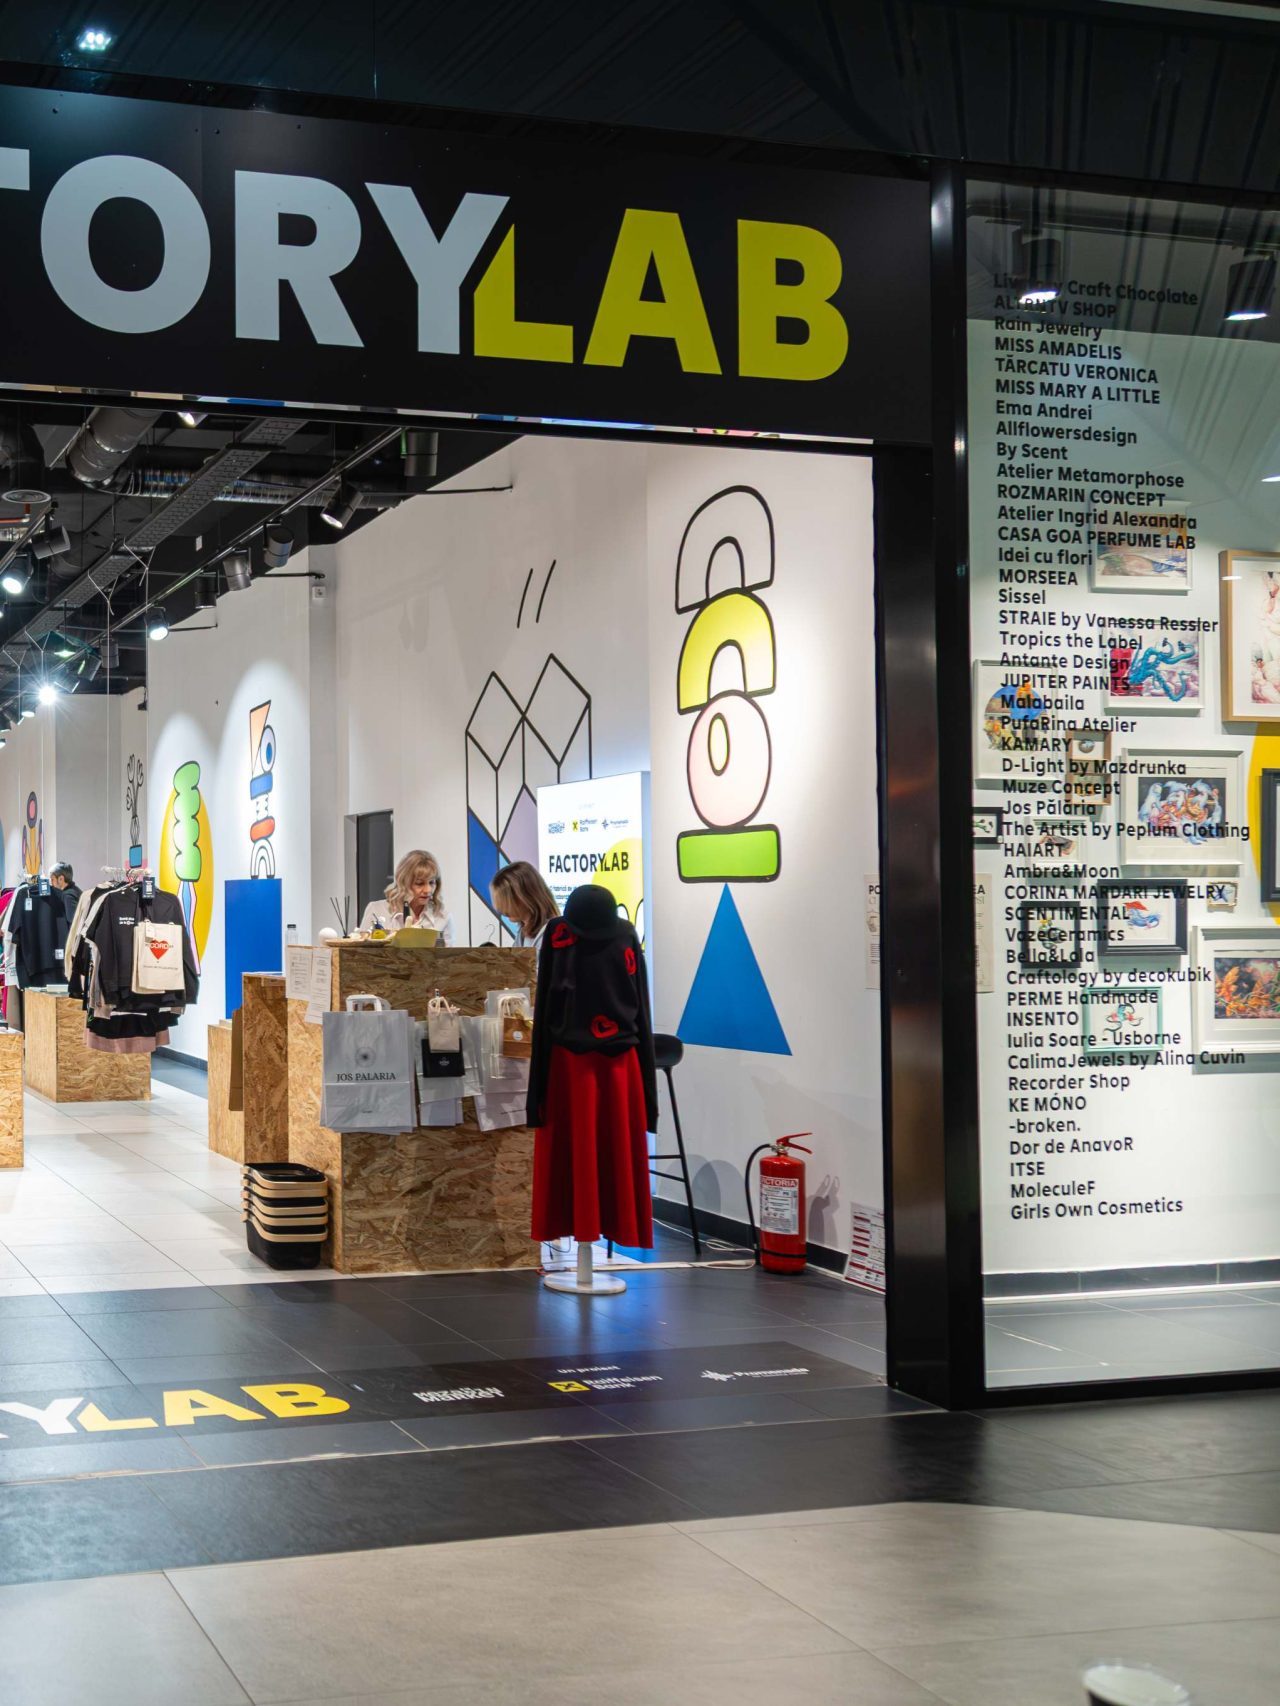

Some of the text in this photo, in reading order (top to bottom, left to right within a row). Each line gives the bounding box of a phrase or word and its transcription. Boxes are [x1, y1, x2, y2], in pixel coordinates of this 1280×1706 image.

[1068, 280, 1111, 298] Craft
[1116, 284, 1198, 306] Chocolate
[1073, 303, 1117, 318] SHOP
[995, 316, 1102, 340] Rain Jewelry
[995, 338, 1122, 360] MISS AMADELIS
[996, 355, 1158, 383] TĂRCATU VERONICA
[996, 379, 1160, 404] MISS MARY A LITTLE
[996, 400, 1092, 420] Ema Andrei
[996, 421, 1137, 446] Allflowersdesign
[997, 442, 1068, 460] By Scent
[997, 463, 1184, 489] Atelier Metamorphose
[998, 484, 1165, 506] ROZMARIN CONCEPT
[998, 505, 1196, 529] Atelier Ingrid Alexandra
[998, 526, 1196, 550] CASA GOA PERFUME LAB
[999, 548, 1092, 565] Idei cu flori
[999, 569, 1078, 586] MORSEEA
[999, 588, 1046, 604] Sissel
[999, 610, 1218, 632] STRAIE by Vanessa Ressler
[1000, 631, 1143, 650] Tropics the Label
[1000, 652, 1130, 672] Antante Design
[1000, 674, 1130, 690] JUPITER PAINTS
[1001, 694, 1084, 710] Malabaila
[1082, 718, 1136, 732] Atelier
[1002, 738, 1072, 752] KAMARY
[1002, 758, 1186, 776] D-Light by Mazdrunka
[1003, 779, 1120, 798] Muze Concept
[1003, 800, 1031, 816] Jos
[1003, 822, 1250, 840] The Artist by Peplum Clothing
[1004, 843, 1064, 857] HAIART
[549, 852, 629, 873] FACTORYLAB
[1004, 864, 1119, 879] Ambra&Moon
[1004, 885, 1225, 900] CORINA MARDARI JEWELRY
[1005, 906, 1131, 922] SCENTIMENTAL
[1007, 967, 1212, 987] Craftology by decokubik
[1008, 990, 1158, 1006] PERME Handmade
[1008, 1012, 1078, 1027] INSENTO
[1049, 1032, 1097, 1047] Soare
[1113, 1031, 1181, 1046] Usborne
[1130, 1052, 1150, 1068] by
[1154, 1051, 1195, 1066] Alina
[1200, 1049, 1245, 1065] Cuvin
[336, 1072, 396, 1081] JOS PALARIA
[1009, 1074, 1130, 1091] Recorder Shop
[1009, 1092, 1087, 1112] KE MÓNO
[1009, 1118, 1081, 1133] -broken.
[1010, 1137, 1133, 1155] Dor de AnavoR
[1011, 1162, 1045, 1177] ITSE
[1011, 1181, 1095, 1198] MoleculeF
[1011, 1197, 1183, 1220] Girls Own Cosmetics
